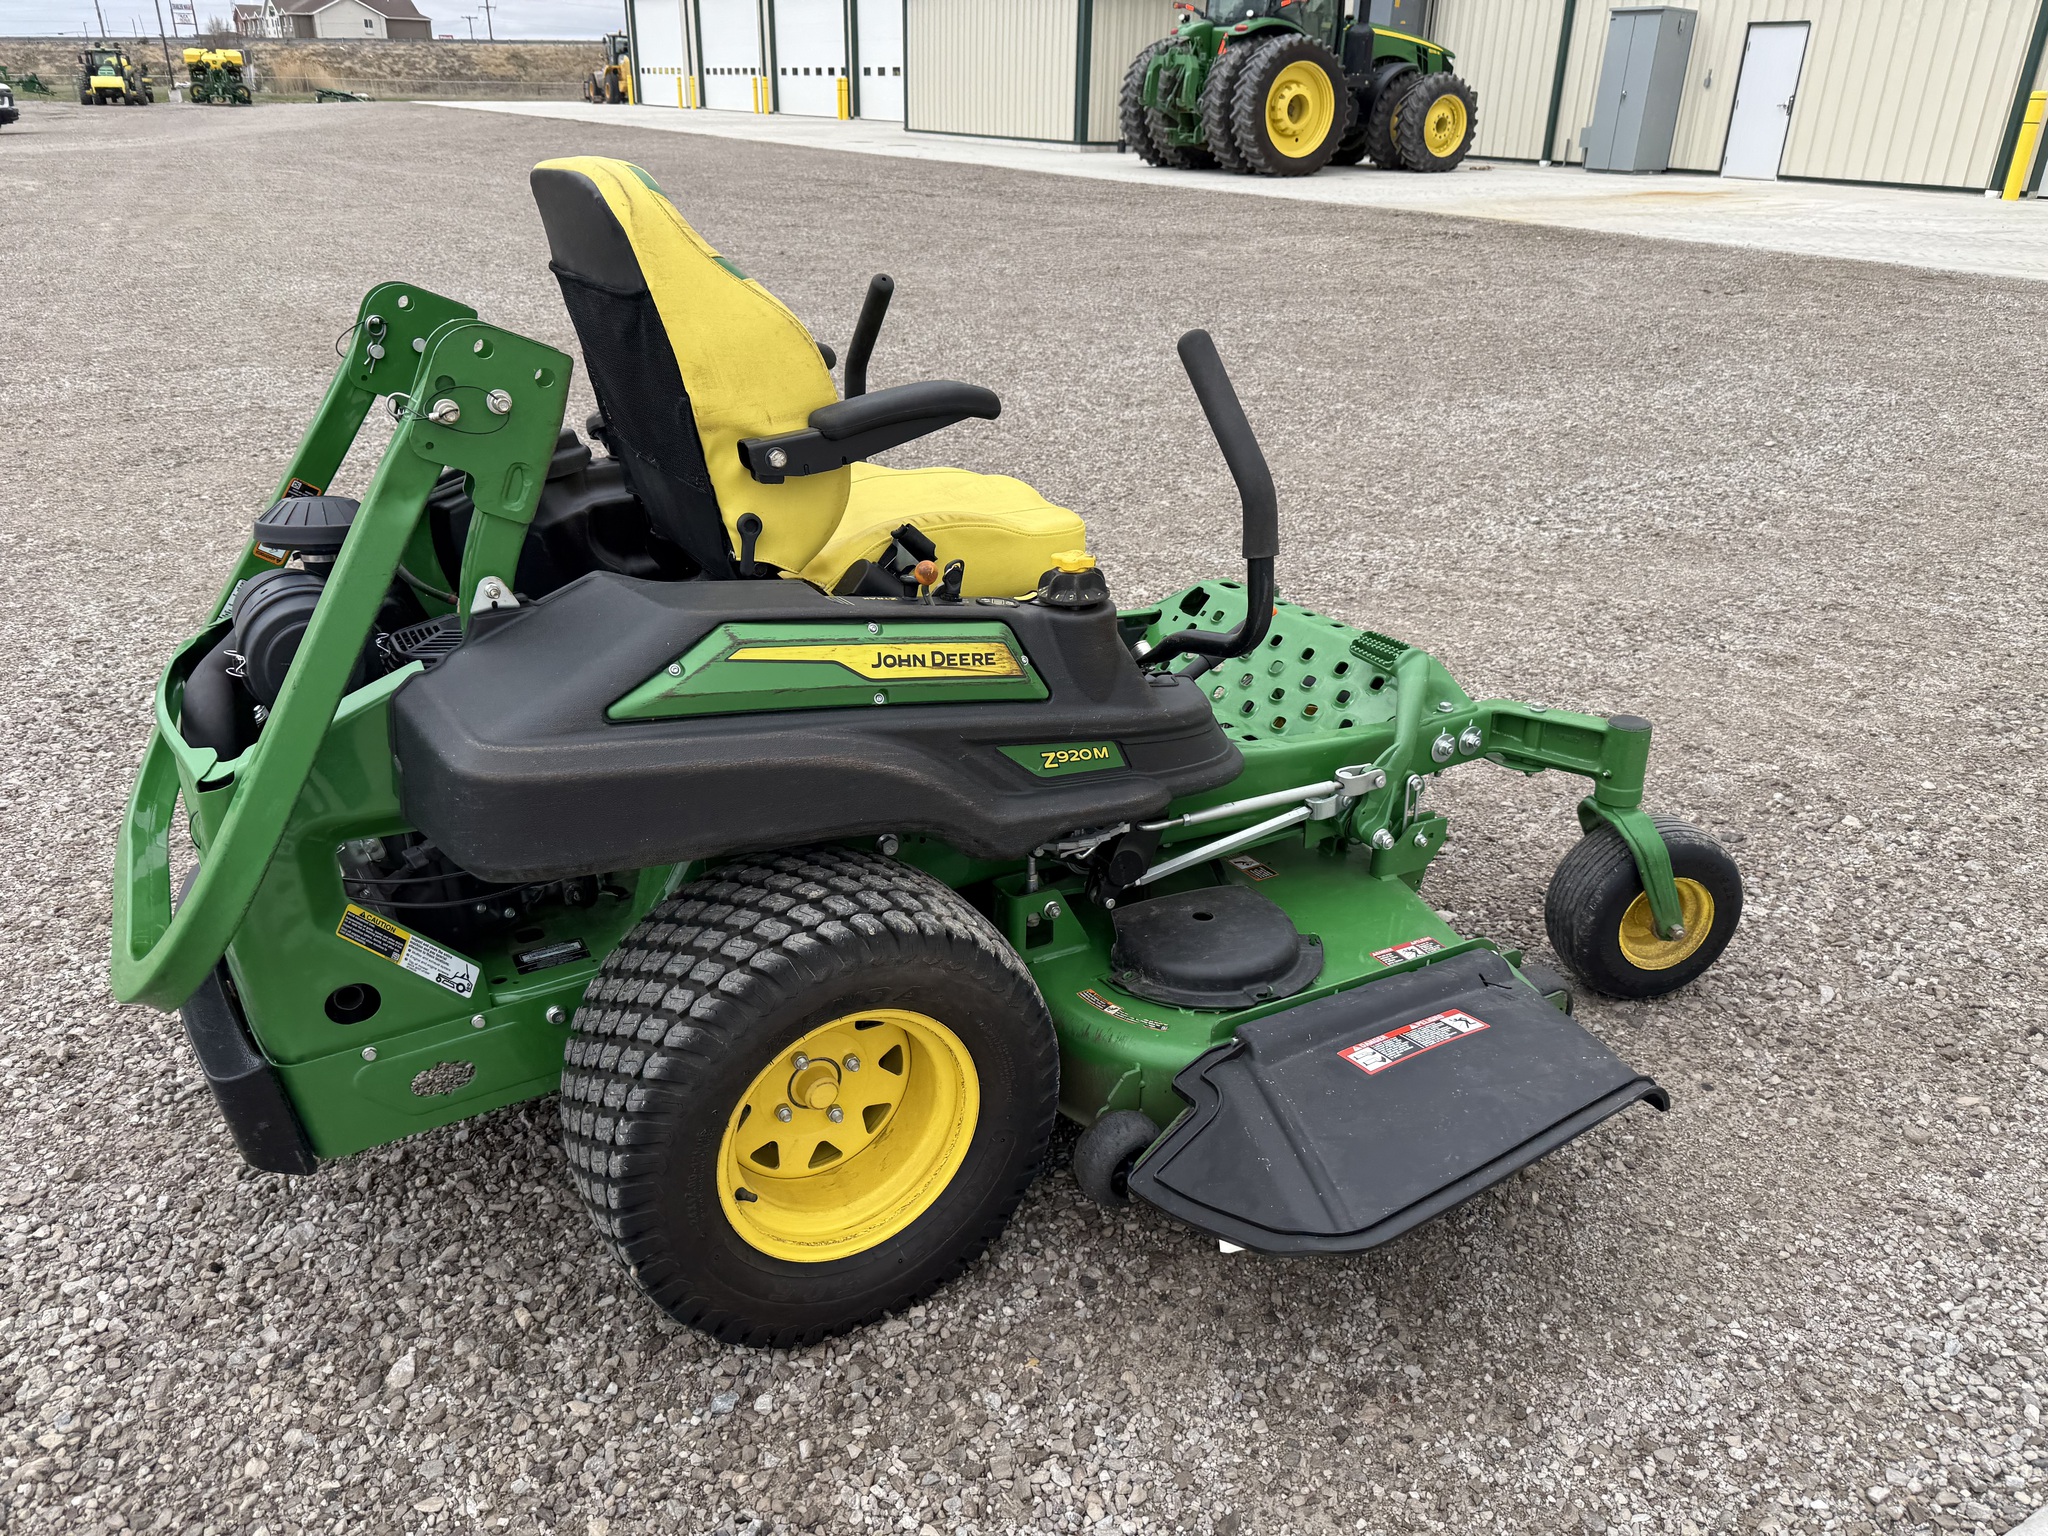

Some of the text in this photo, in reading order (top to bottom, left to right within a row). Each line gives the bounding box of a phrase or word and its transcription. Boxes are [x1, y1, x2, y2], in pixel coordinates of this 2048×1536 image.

[871, 650, 996, 669] JOHN DEERE
[1041, 746, 1109, 769] Z920M
[366, 914, 397, 934] CAUTION
